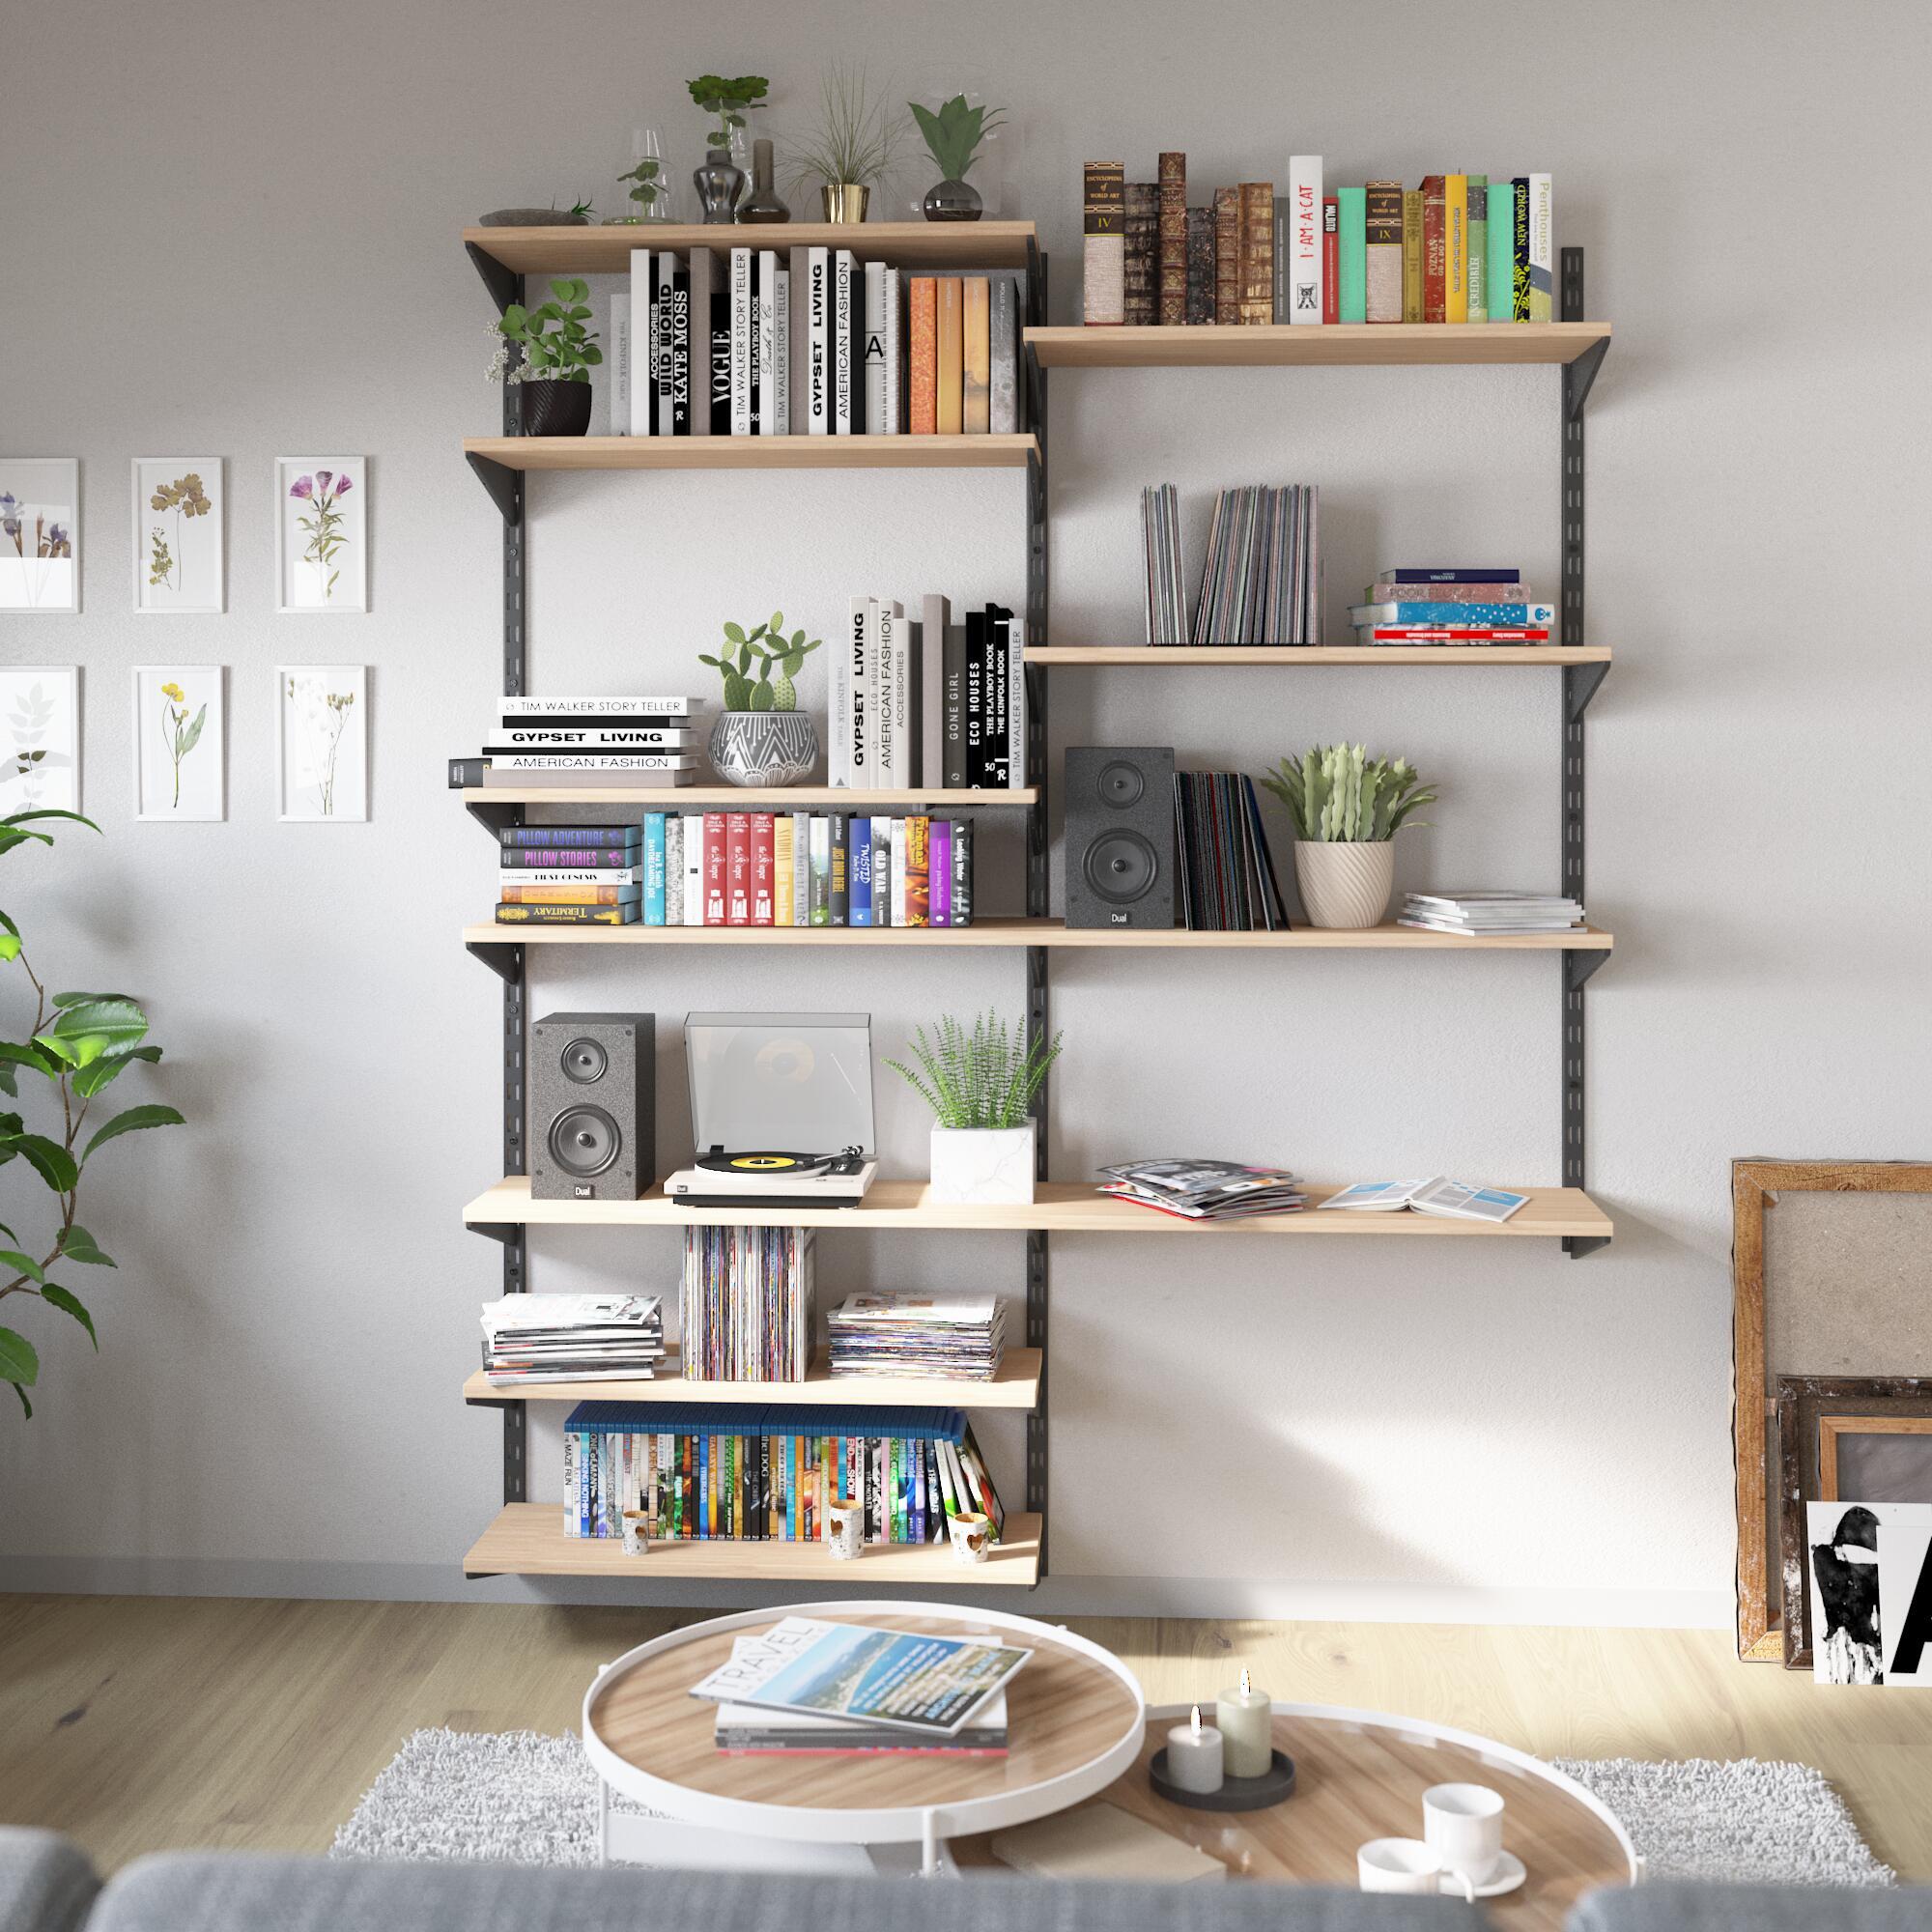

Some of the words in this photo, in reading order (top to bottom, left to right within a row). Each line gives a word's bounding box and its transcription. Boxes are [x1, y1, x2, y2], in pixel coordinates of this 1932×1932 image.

[1298, 185, 1314, 208] CAT
[1517, 185, 1527, 222] WORLD
[1097, 216, 1112, 228] IV
[1517, 223, 1527, 246] NEW
[1539, 182, 1550, 263] Penthouses
[735, 254, 746, 295] TELLER
[751, 295, 760, 322] BOOK
[778, 282, 786, 316] TELLER
[812, 264, 822, 327] LIVING
[838, 262, 848, 330] FASHION
[660, 284, 672, 347] WORLD
[673, 290, 688, 346] MOSS
[735, 298, 746, 337] STORY
[650, 302, 659, 381] ACCESSORIES
[751, 323, 760, 366] PLAYBOY
[778, 320, 786, 353] STORY
[866, 335, 884, 358] A
[660, 353, 672, 396] WILD
[673, 351, 688, 405] KATE
[711, 329, 731, 404] VOGUE
[735, 341, 746, 391] WALKER
[751, 367, 760, 387] THE
[778, 355, 786, 398] WALKER
[812, 341, 822, 416] GYPSET
[838, 335, 848, 419] AMERICAN
[735, 395, 746, 416] TIM
[778, 401, 786, 418] TIM
[854, 612, 864, 676] LIVING
[881, 611, 892, 679] FASHION
[1011, 631, 1021, 665] TELLER
[969, 662, 980, 712] HOUSES
[1011, 668, 1021, 701] STORY
[521, 702, 541, 712] TIM
[546, 702, 595, 712] WALKER
[599, 702, 637, 712] STORY
[640, 702, 680, 712] TELLER
[949, 706, 958, 740] GONE
[512, 732, 586, 742] GYPSET
[600, 732, 663, 742] LIVING
[854, 690, 864, 766] GYPSET
[881, 685, 892, 769] AMERICAN
[969, 721, 980, 746] ECO
[1011, 704, 1021, 748] WALKER
[513, 758, 594, 767] AMERICAN
[601, 758, 668, 767] FASHION
[1011, 751, 1021, 768] TIM
[517, 831, 550, 845] PILLOW
[554, 831, 604, 845] ADVENTURE
[525, 851, 557, 866] PILLOW
[560, 851, 597, 866] STORIES
[860, 843, 870, 884] TWISTED
[875, 849, 887, 869] OLD
[647, 887, 656, 899] JOE
[875, 871, 887, 894] WAR
[1112, 913, 1127, 923] Dual
[575, 1186, 590, 1196] Dual
[761, 1435, 770, 1451] the
[846, 1438, 855, 1456] END
[581, 1452, 589, 1483] SINKING
[846, 1468, 855, 1494] SHOW
[927, 1467, 937, 1485] THE
[581, 1484, 589, 1518] NOTHING
[705, 1627, 814, 1689] TRAVEL
